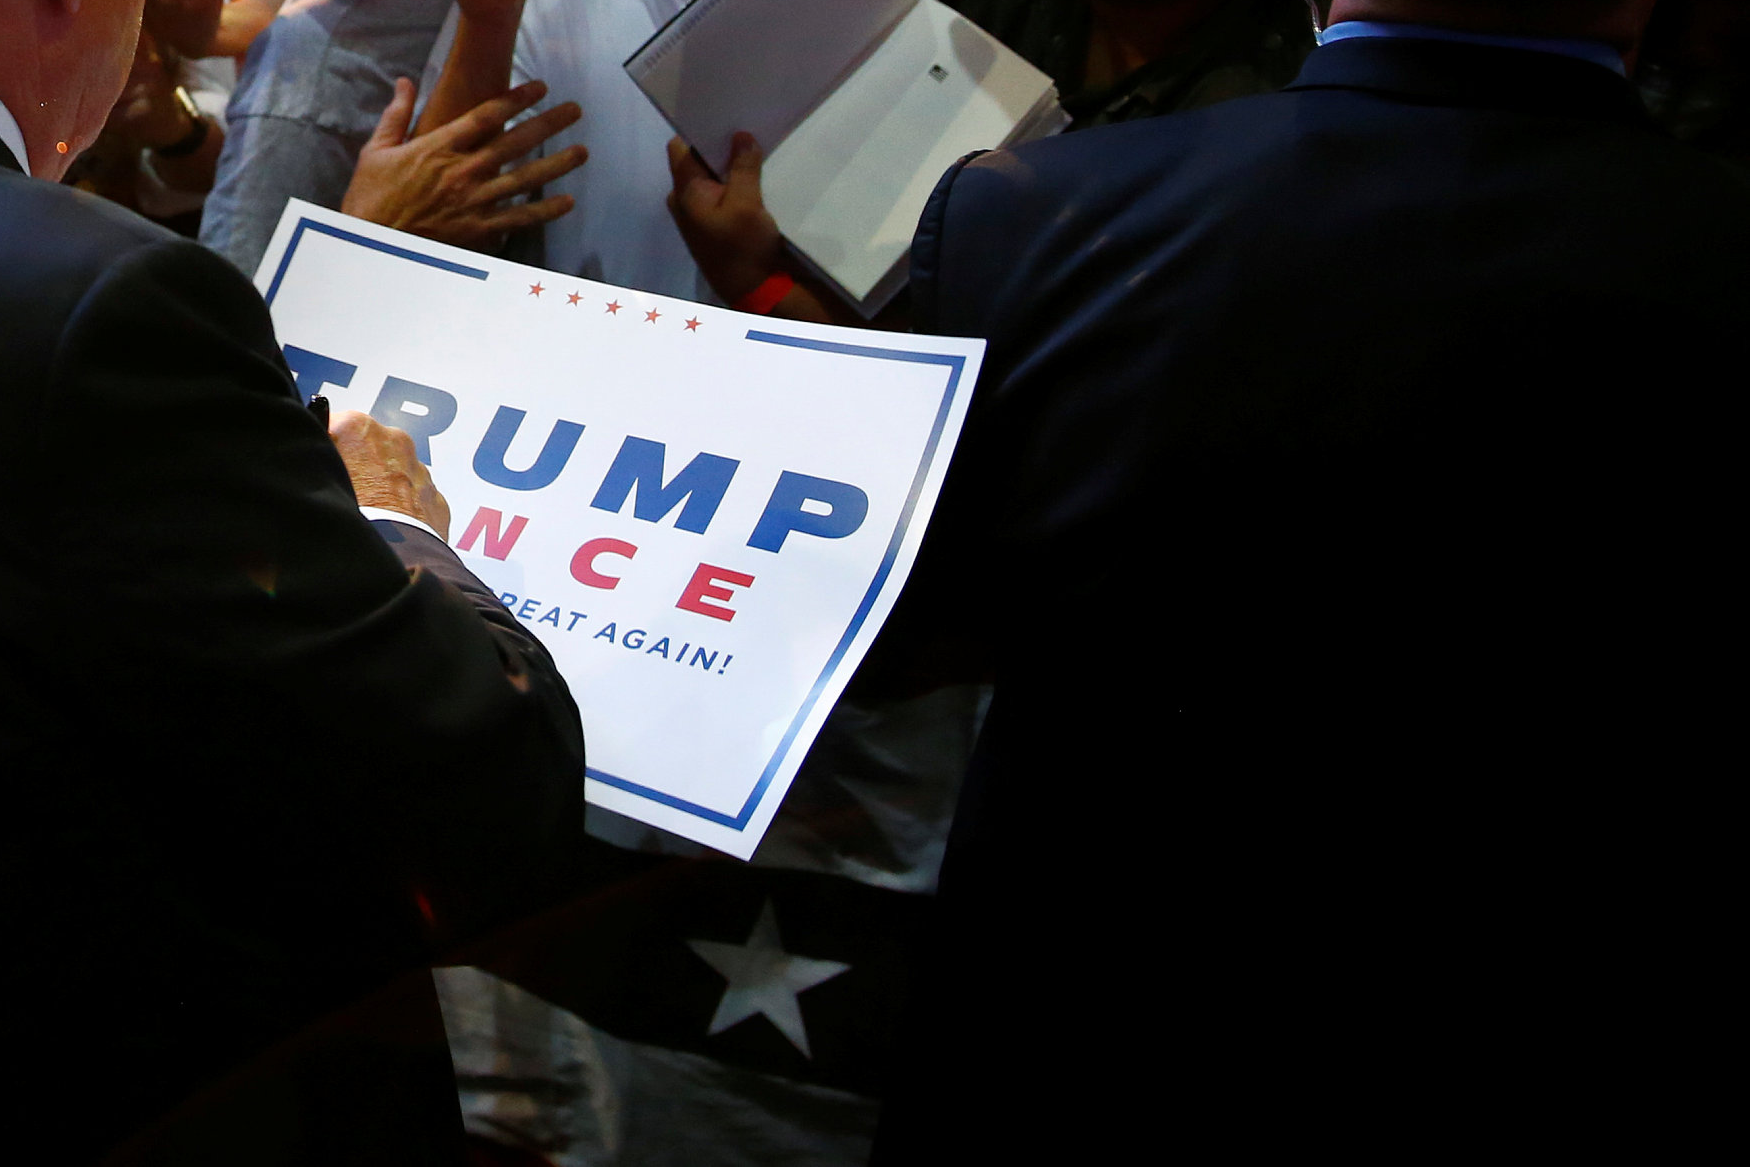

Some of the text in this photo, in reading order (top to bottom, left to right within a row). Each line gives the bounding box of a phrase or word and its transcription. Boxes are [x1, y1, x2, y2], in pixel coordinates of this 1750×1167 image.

[281, 344, 869, 553] TRUMP
[456, 506, 755, 622] NCE
[499, 590, 734, 675] REAT AGAIN!
